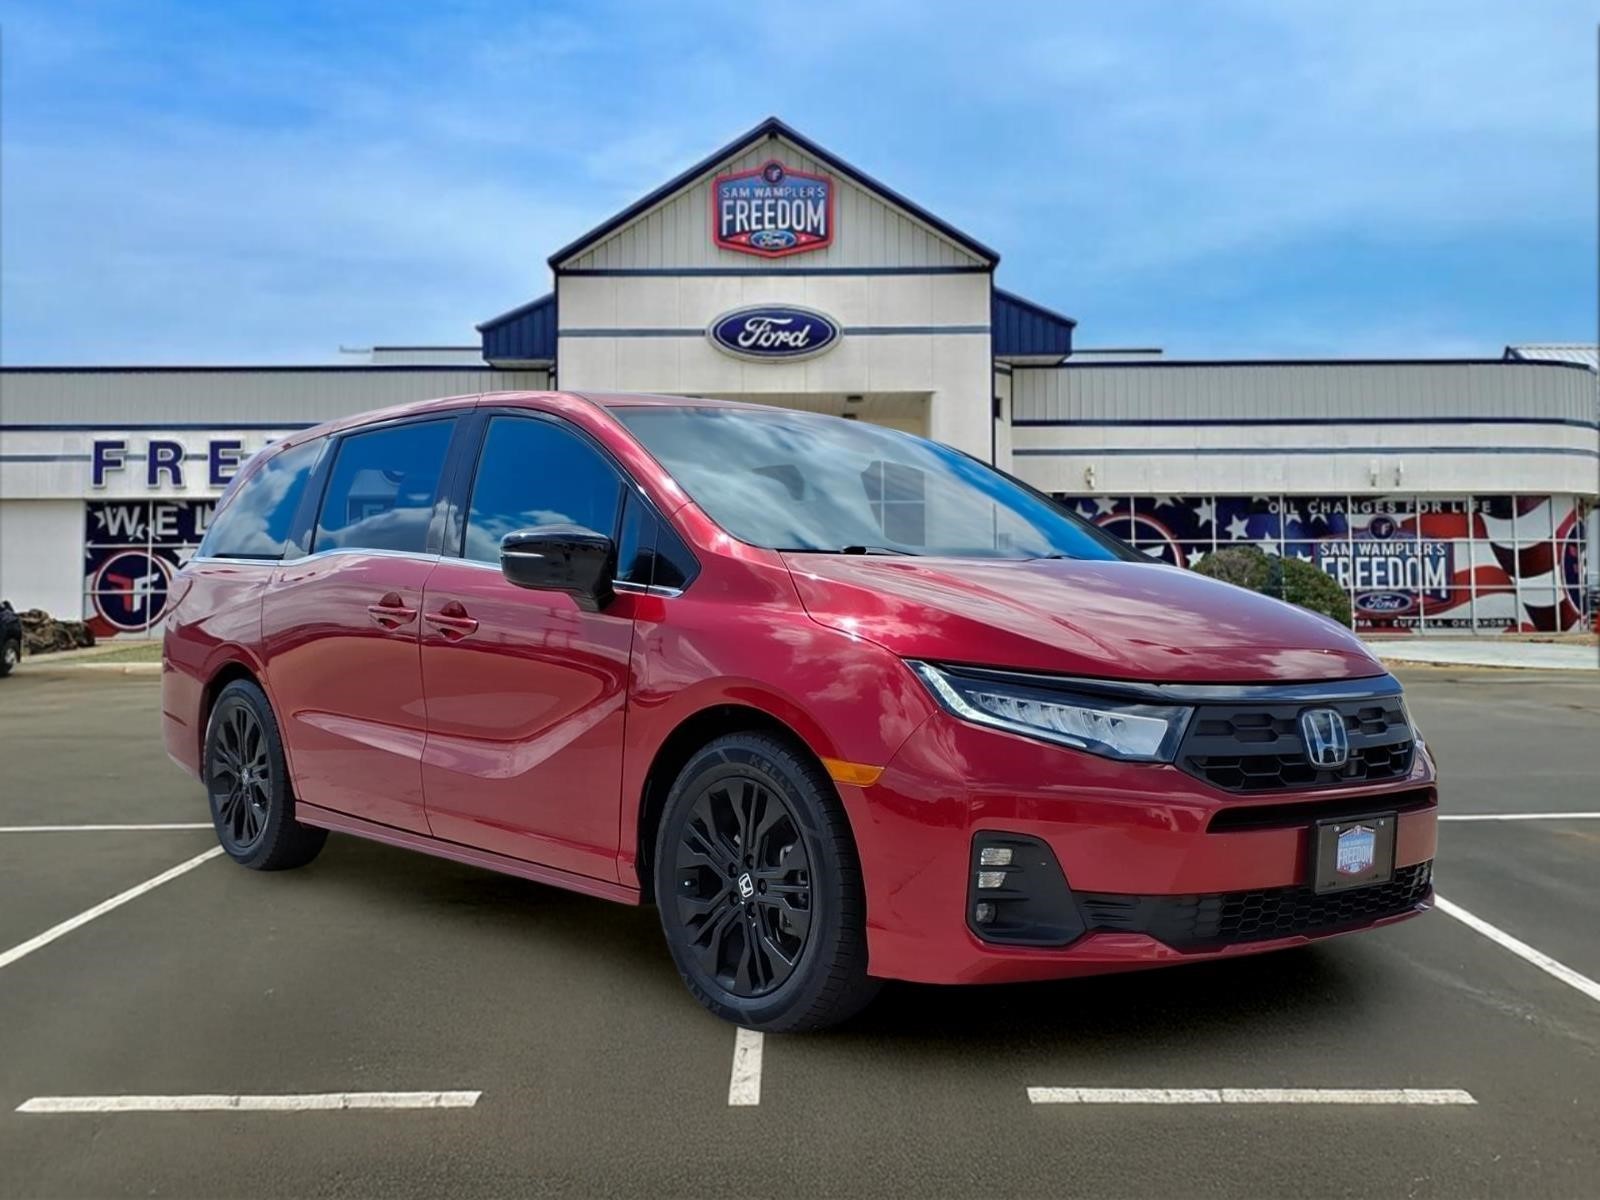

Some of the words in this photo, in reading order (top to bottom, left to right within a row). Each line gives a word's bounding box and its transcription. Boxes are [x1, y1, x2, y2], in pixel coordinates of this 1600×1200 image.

[722, 187, 750, 198] SAM
[722, 199, 826, 236] FREEDOM
[737, 316, 811, 347] Ford
[93, 440, 279, 485] FRE
[1268, 501, 1299, 514] OIL
[1308, 500, 1397, 514] CHANGES
[1406, 501, 1442, 514] FOR
[1451, 501, 1491, 514] LIFE
[1321, 556, 1447, 599] FREEDOM
[1365, 595, 1400, 609] Ford
